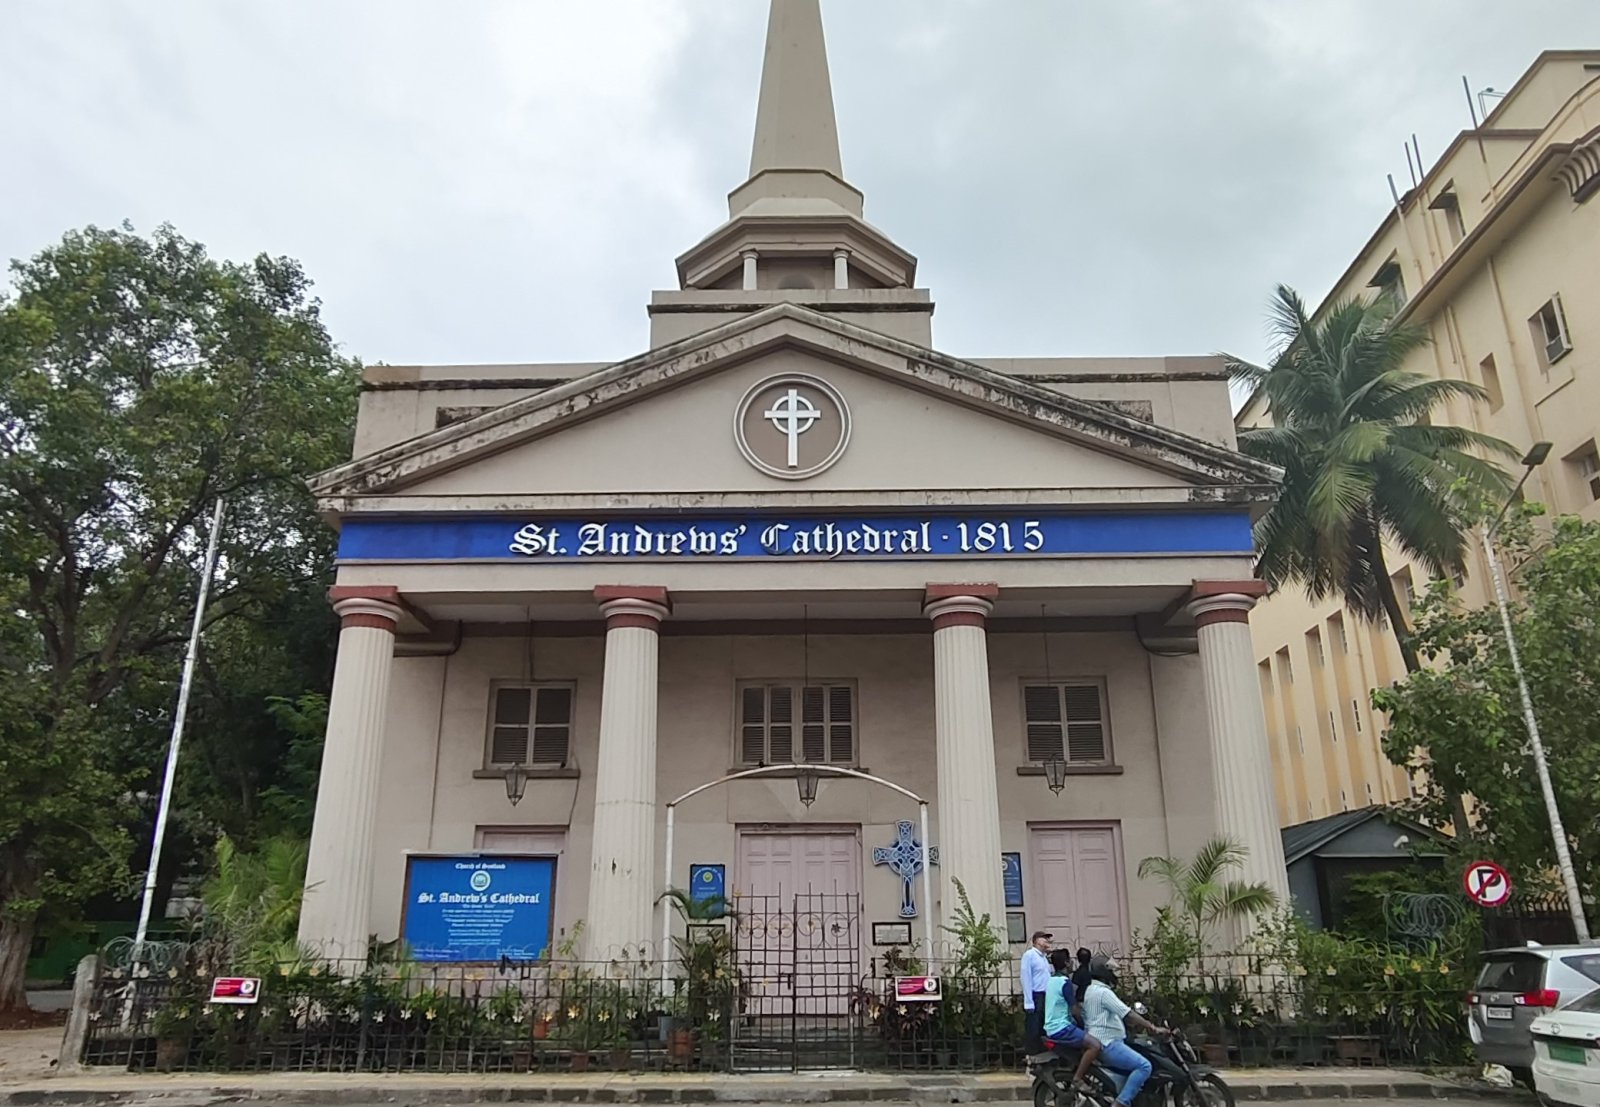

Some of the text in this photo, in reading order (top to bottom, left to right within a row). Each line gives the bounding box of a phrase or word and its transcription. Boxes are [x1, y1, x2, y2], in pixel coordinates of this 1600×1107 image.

[509, 523, 567, 555] St.
[760, 522, 932, 559] Cathedral
[956, 521, 1044, 552] 1815
[417, 892, 540, 905] St. Andrew's Cathedral
